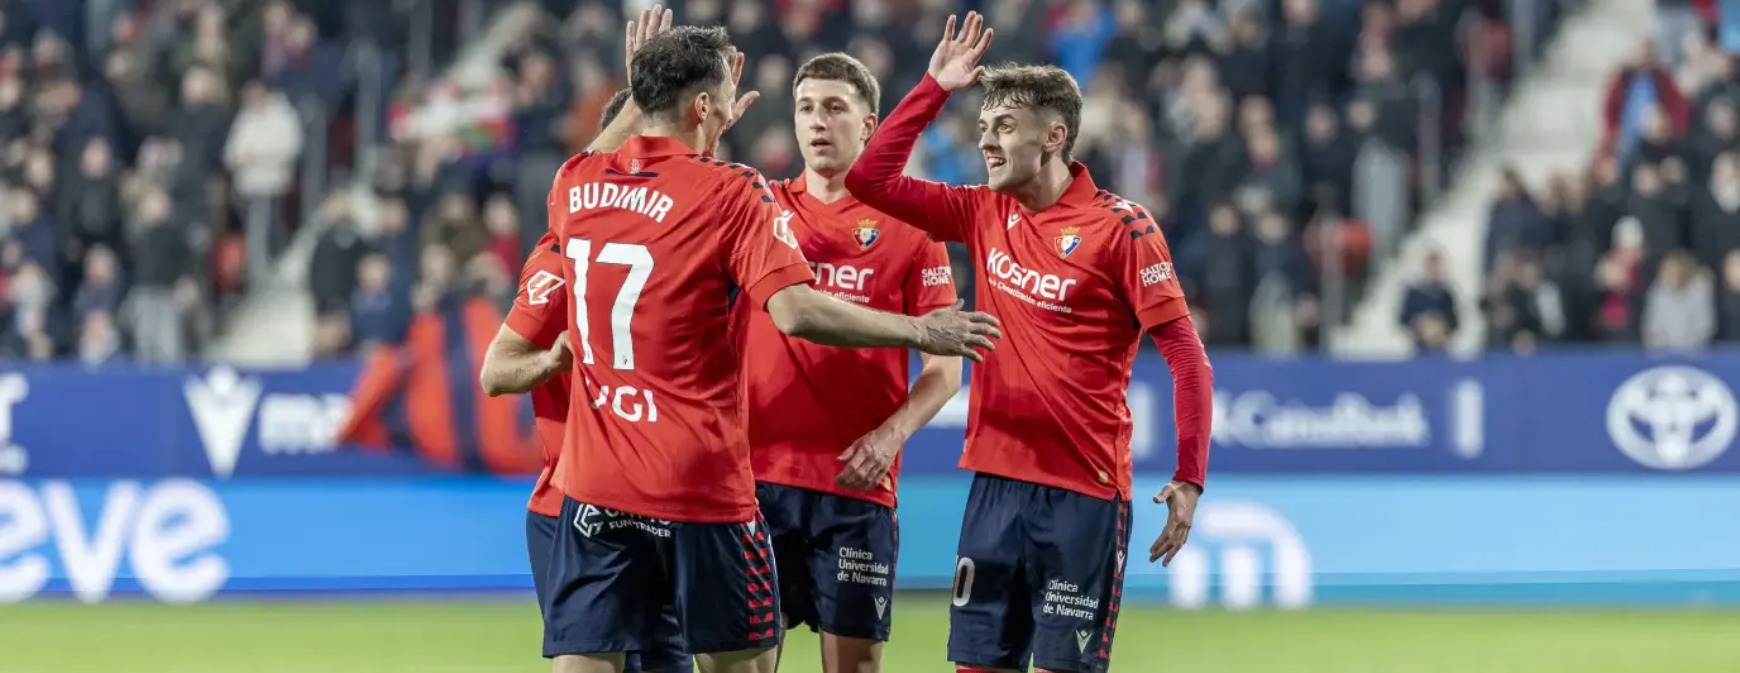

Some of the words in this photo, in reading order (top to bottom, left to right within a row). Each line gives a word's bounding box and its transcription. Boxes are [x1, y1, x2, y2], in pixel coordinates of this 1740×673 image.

[569, 182, 674, 223] BUDIMIR
[922, 276, 950, 287] HOME
[1141, 271, 1172, 287] HOME
[566, 237, 655, 370] 17
[838, 559, 889, 575] Universidad
[837, 570, 850, 582] de
[852, 572, 887, 587] Navarra
[1045, 591, 1099, 609] Universidad
[1042, 603, 1054, 614] de
[1056, 604, 1094, 620] Navarra
